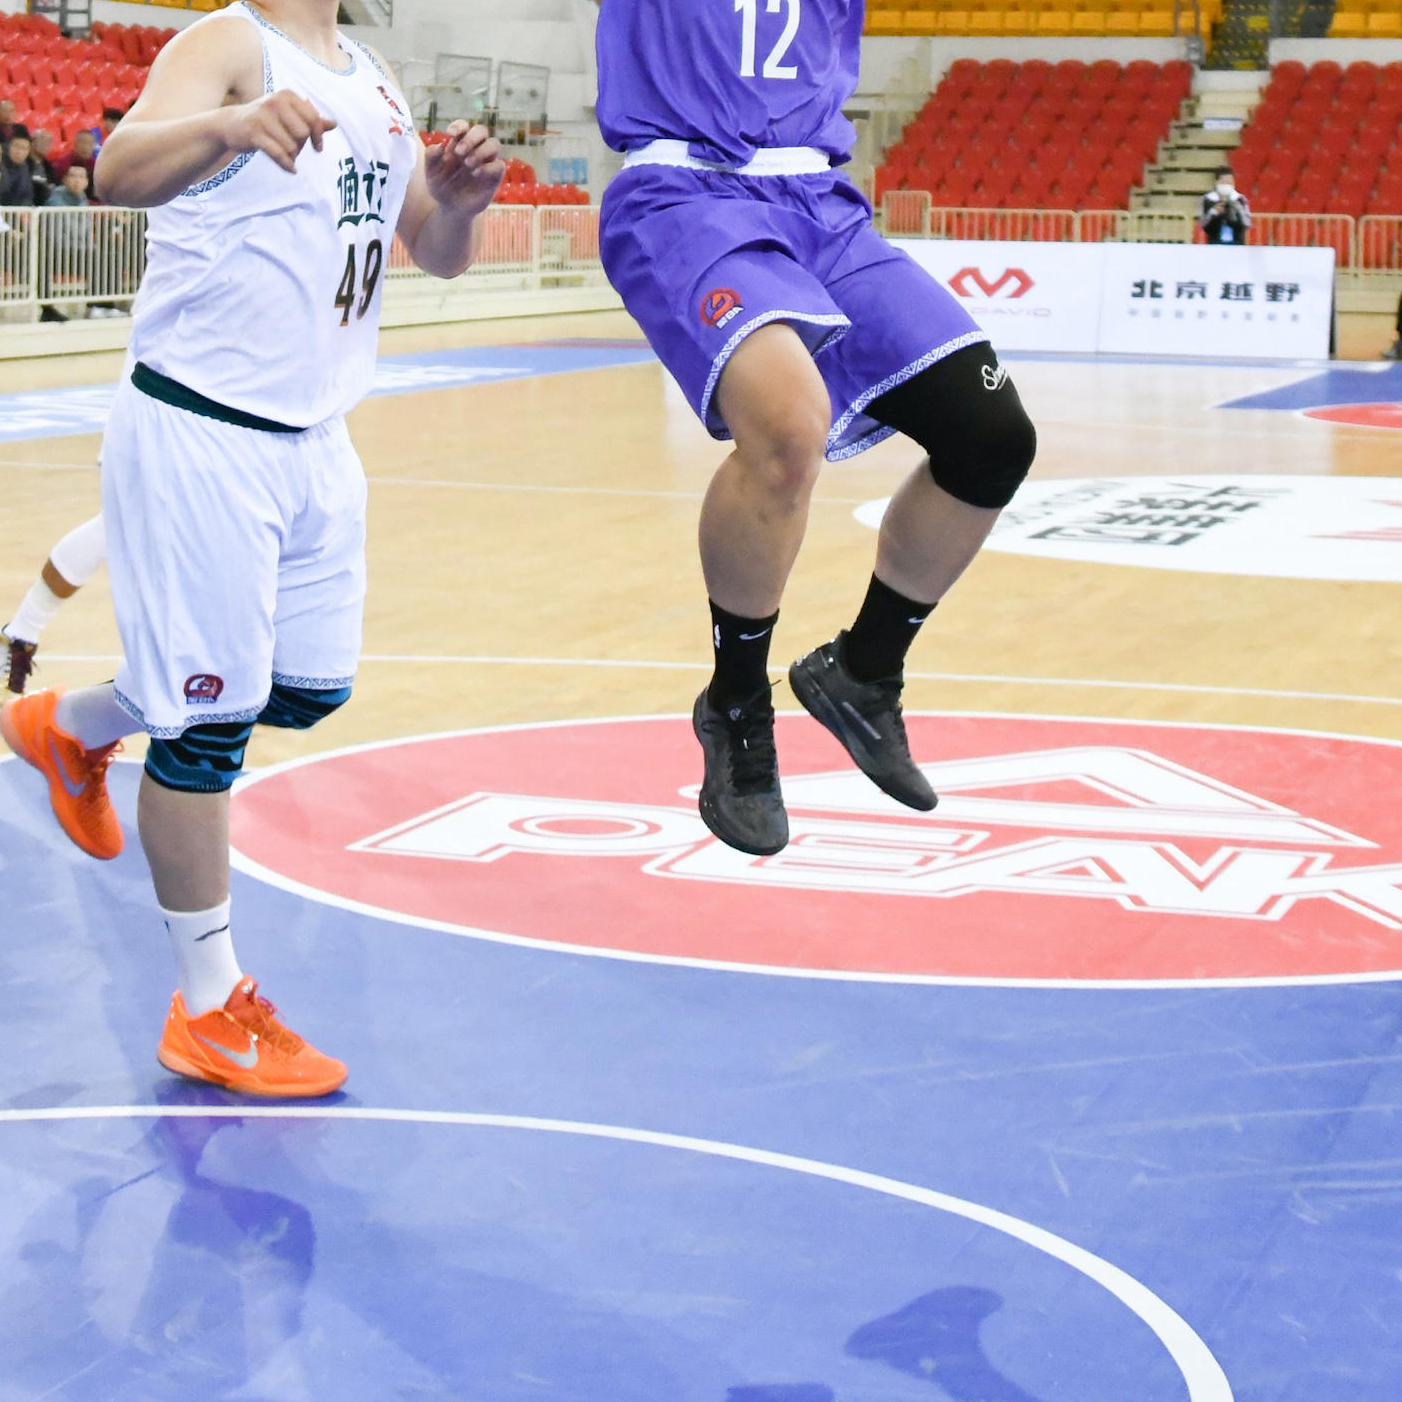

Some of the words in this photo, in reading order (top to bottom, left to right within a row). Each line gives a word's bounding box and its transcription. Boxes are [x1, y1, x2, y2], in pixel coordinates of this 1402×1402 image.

[336, 157, 391, 230] 通辽
[334, 238, 383, 327] 49
[1130, 278, 1302, 303] 北京越野
